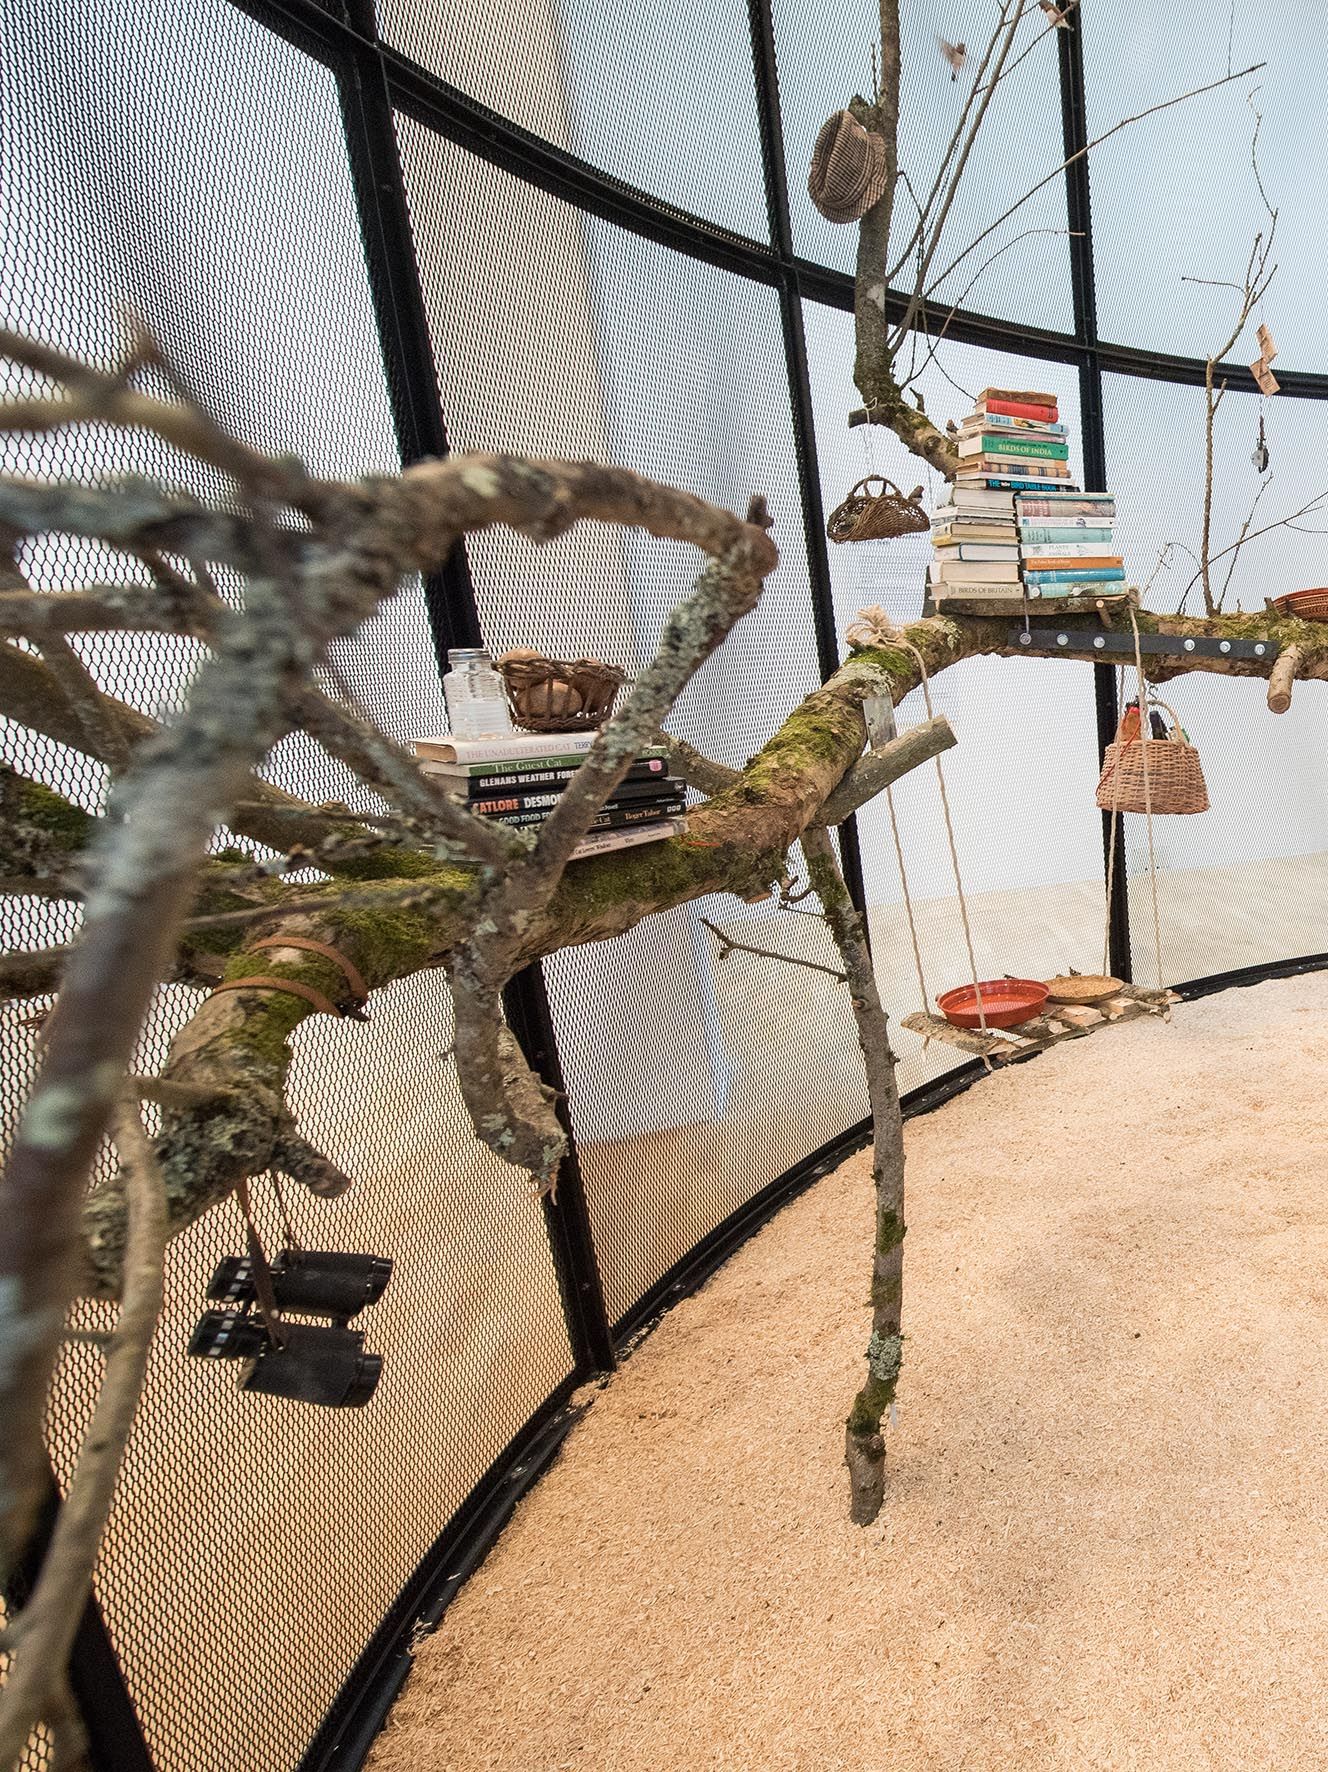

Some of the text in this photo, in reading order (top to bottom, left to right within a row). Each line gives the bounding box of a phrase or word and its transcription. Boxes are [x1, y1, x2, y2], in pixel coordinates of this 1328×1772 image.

[998, 444, 1019, 452] BIRDS
[494, 759, 562, 773] The Guest Cat
[480, 770, 578, 787] GLENANS WEATHER FORE
[521, 813, 540, 822] FOOD
